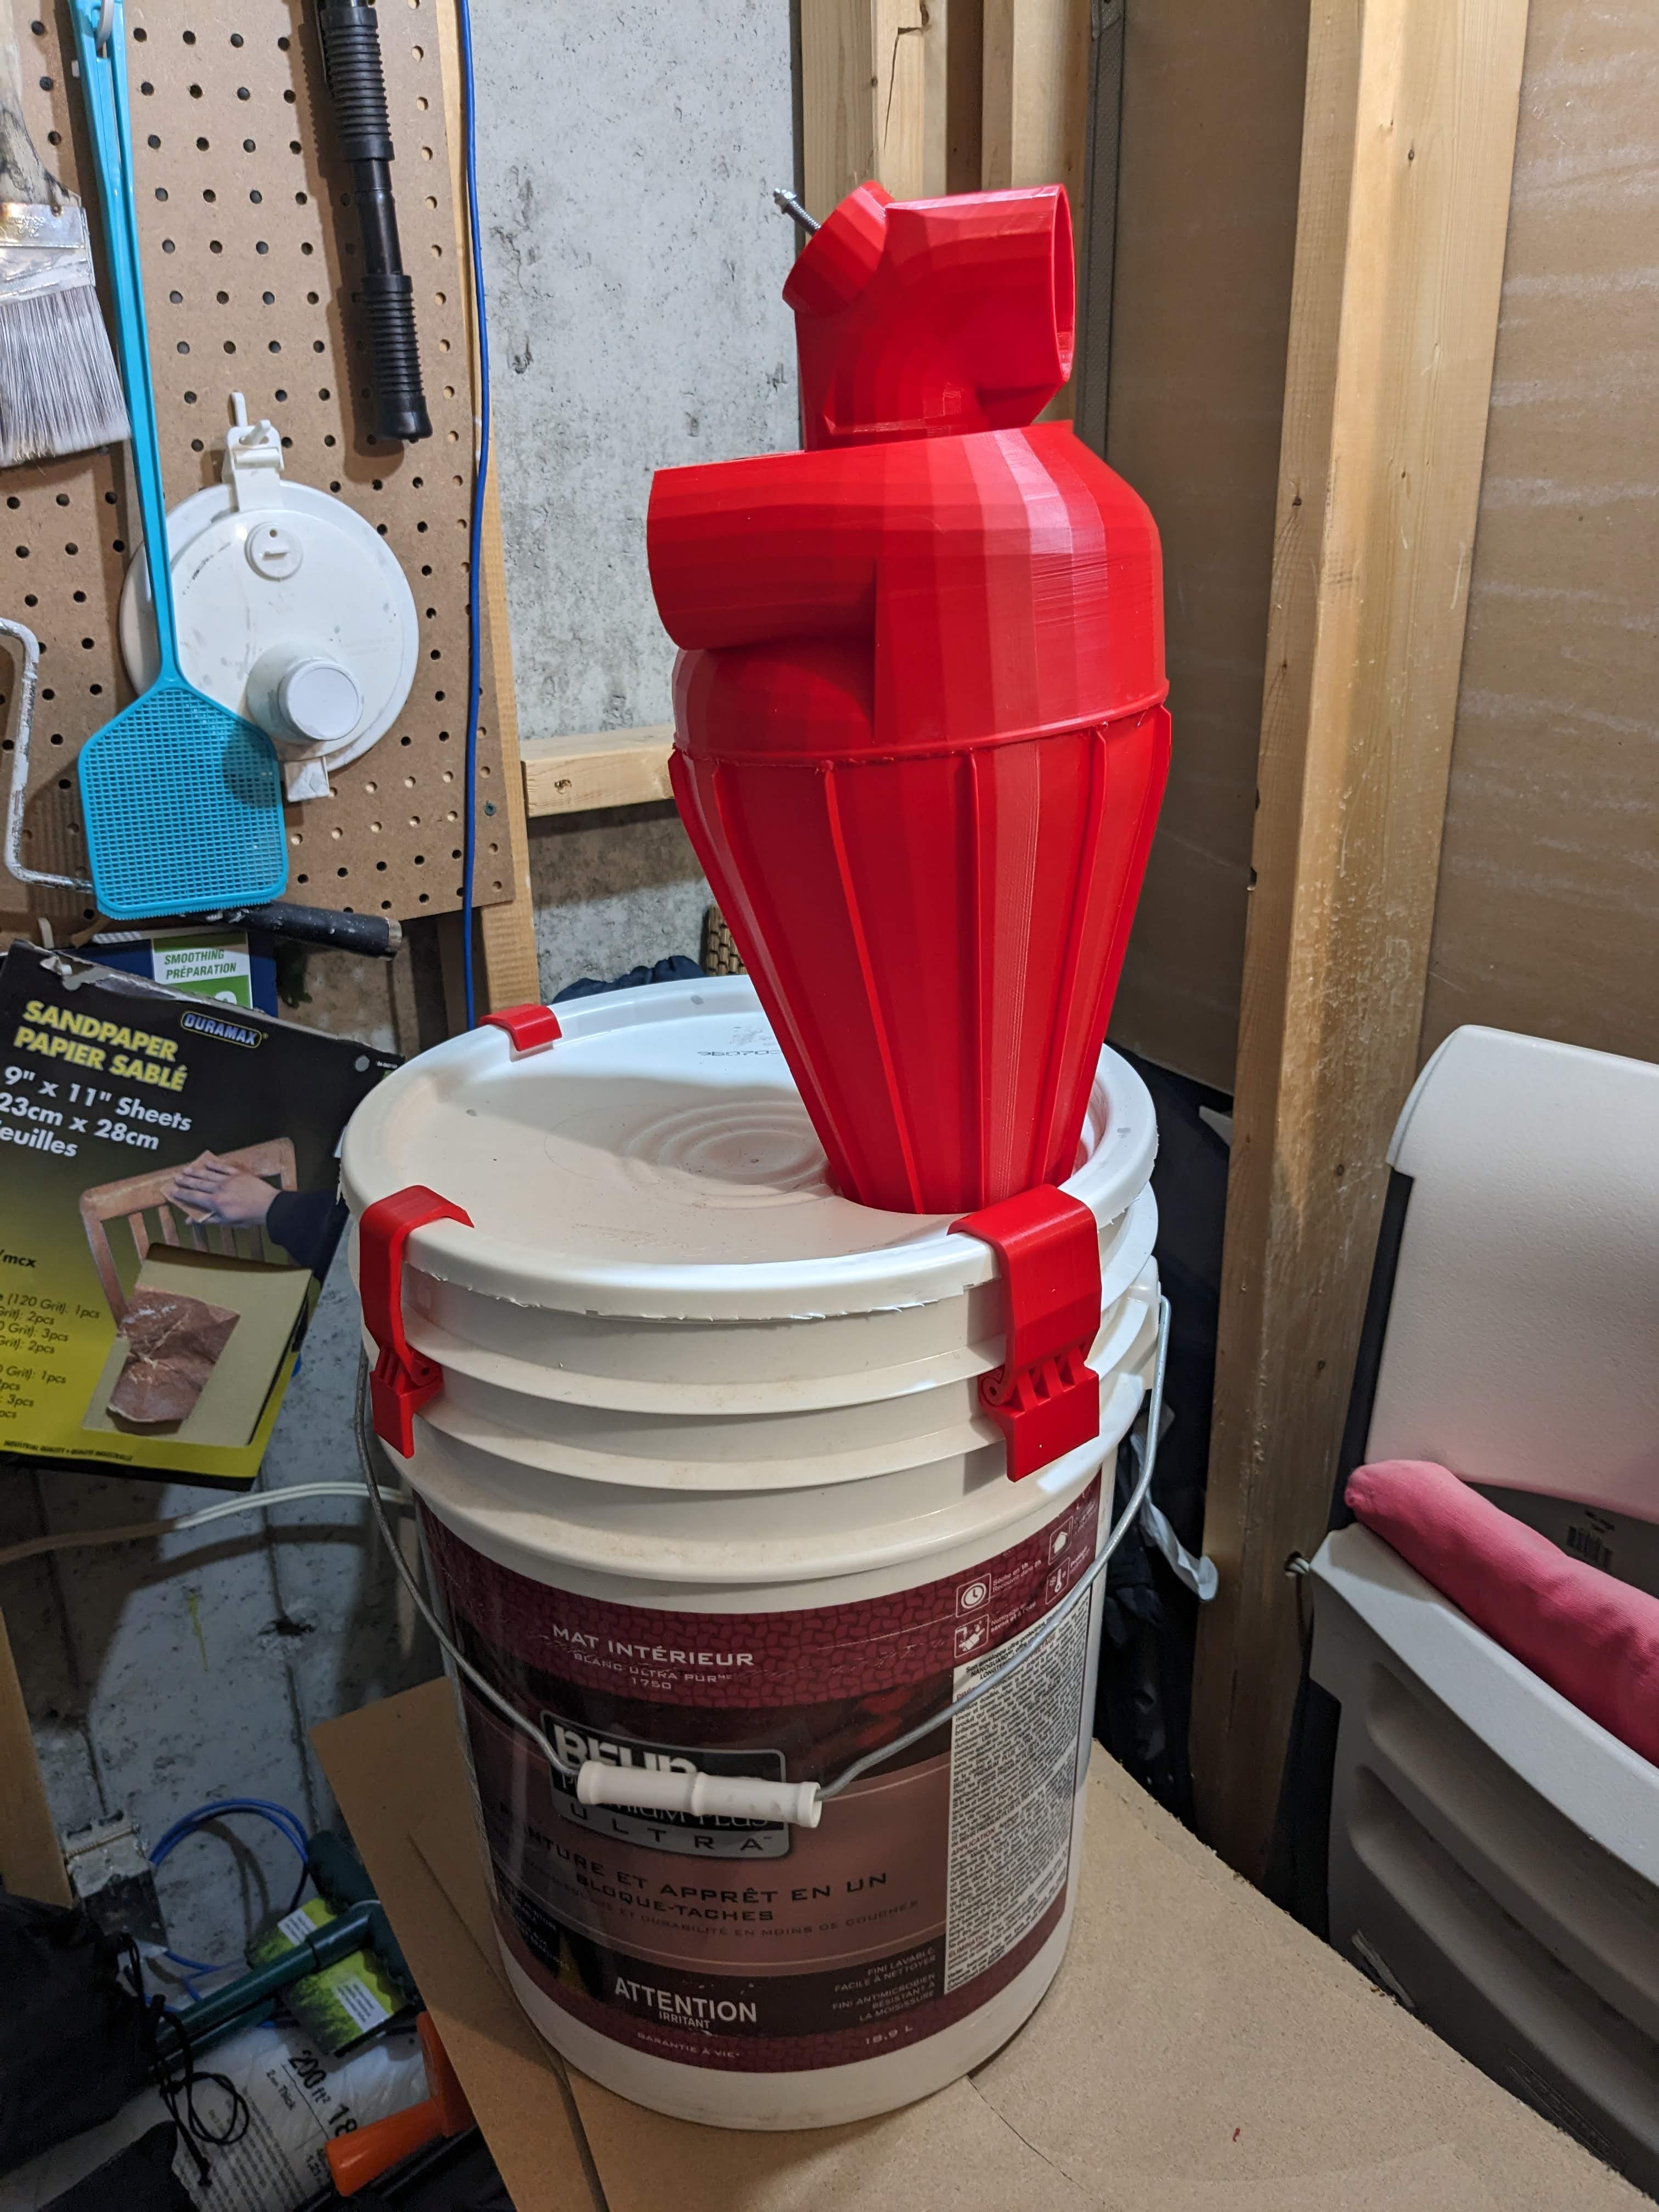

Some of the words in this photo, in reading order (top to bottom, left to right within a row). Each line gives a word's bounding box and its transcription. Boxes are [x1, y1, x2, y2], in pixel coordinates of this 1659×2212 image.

[165, 949, 224, 965] SMOOTHING
[166, 963, 236, 979] PRÉPARATION
[22, 1001, 178, 1063] SANDPAPER
[184, 1014, 258, 1045] DURAMAX
[14, 1026, 106, 1070] PAPIER
[109, 1054, 188, 1092] SABLÉ
[5, 1066, 36, 1085] 9"
[38, 1081, 59, 1097] x
[69, 1084, 112, 1107] 11"
[115, 1097, 192, 1131] Sheets
[0, 1092, 63, 1126] 23cm
[69, 1117, 89, 1132] x
[94, 1119, 159, 1150] 28cm
[0, 1120, 78, 1157] euilles
[28, 1311, 54, 1324] 2pcs
[28, 1340, 55, 1353] 2pcs
[42, 1328, 69, 1341] 3pcs
[552, 1624, 599, 1647] MAT
[608, 1640, 754, 1667] INTÉRIEUR
[574, 1651, 623, 1672] BLANC
[629, 1666, 678, 1680] ULTRA
[631, 1677, 672, 1690] 1750
[577, 1874, 774, 1921] BLOQUE-TACHES
[616, 1871, 647, 1889] ET
[659, 1882, 778, 1903] APPRÊT
[791, 1885, 832, 1901] EN
[847, 1872, 887, 1893] UN
[615, 1977, 757, 2023] ATTENTION
[659, 2011, 711, 2029] IRRITANT
[637, 2032, 697, 2053] GARANTIE
